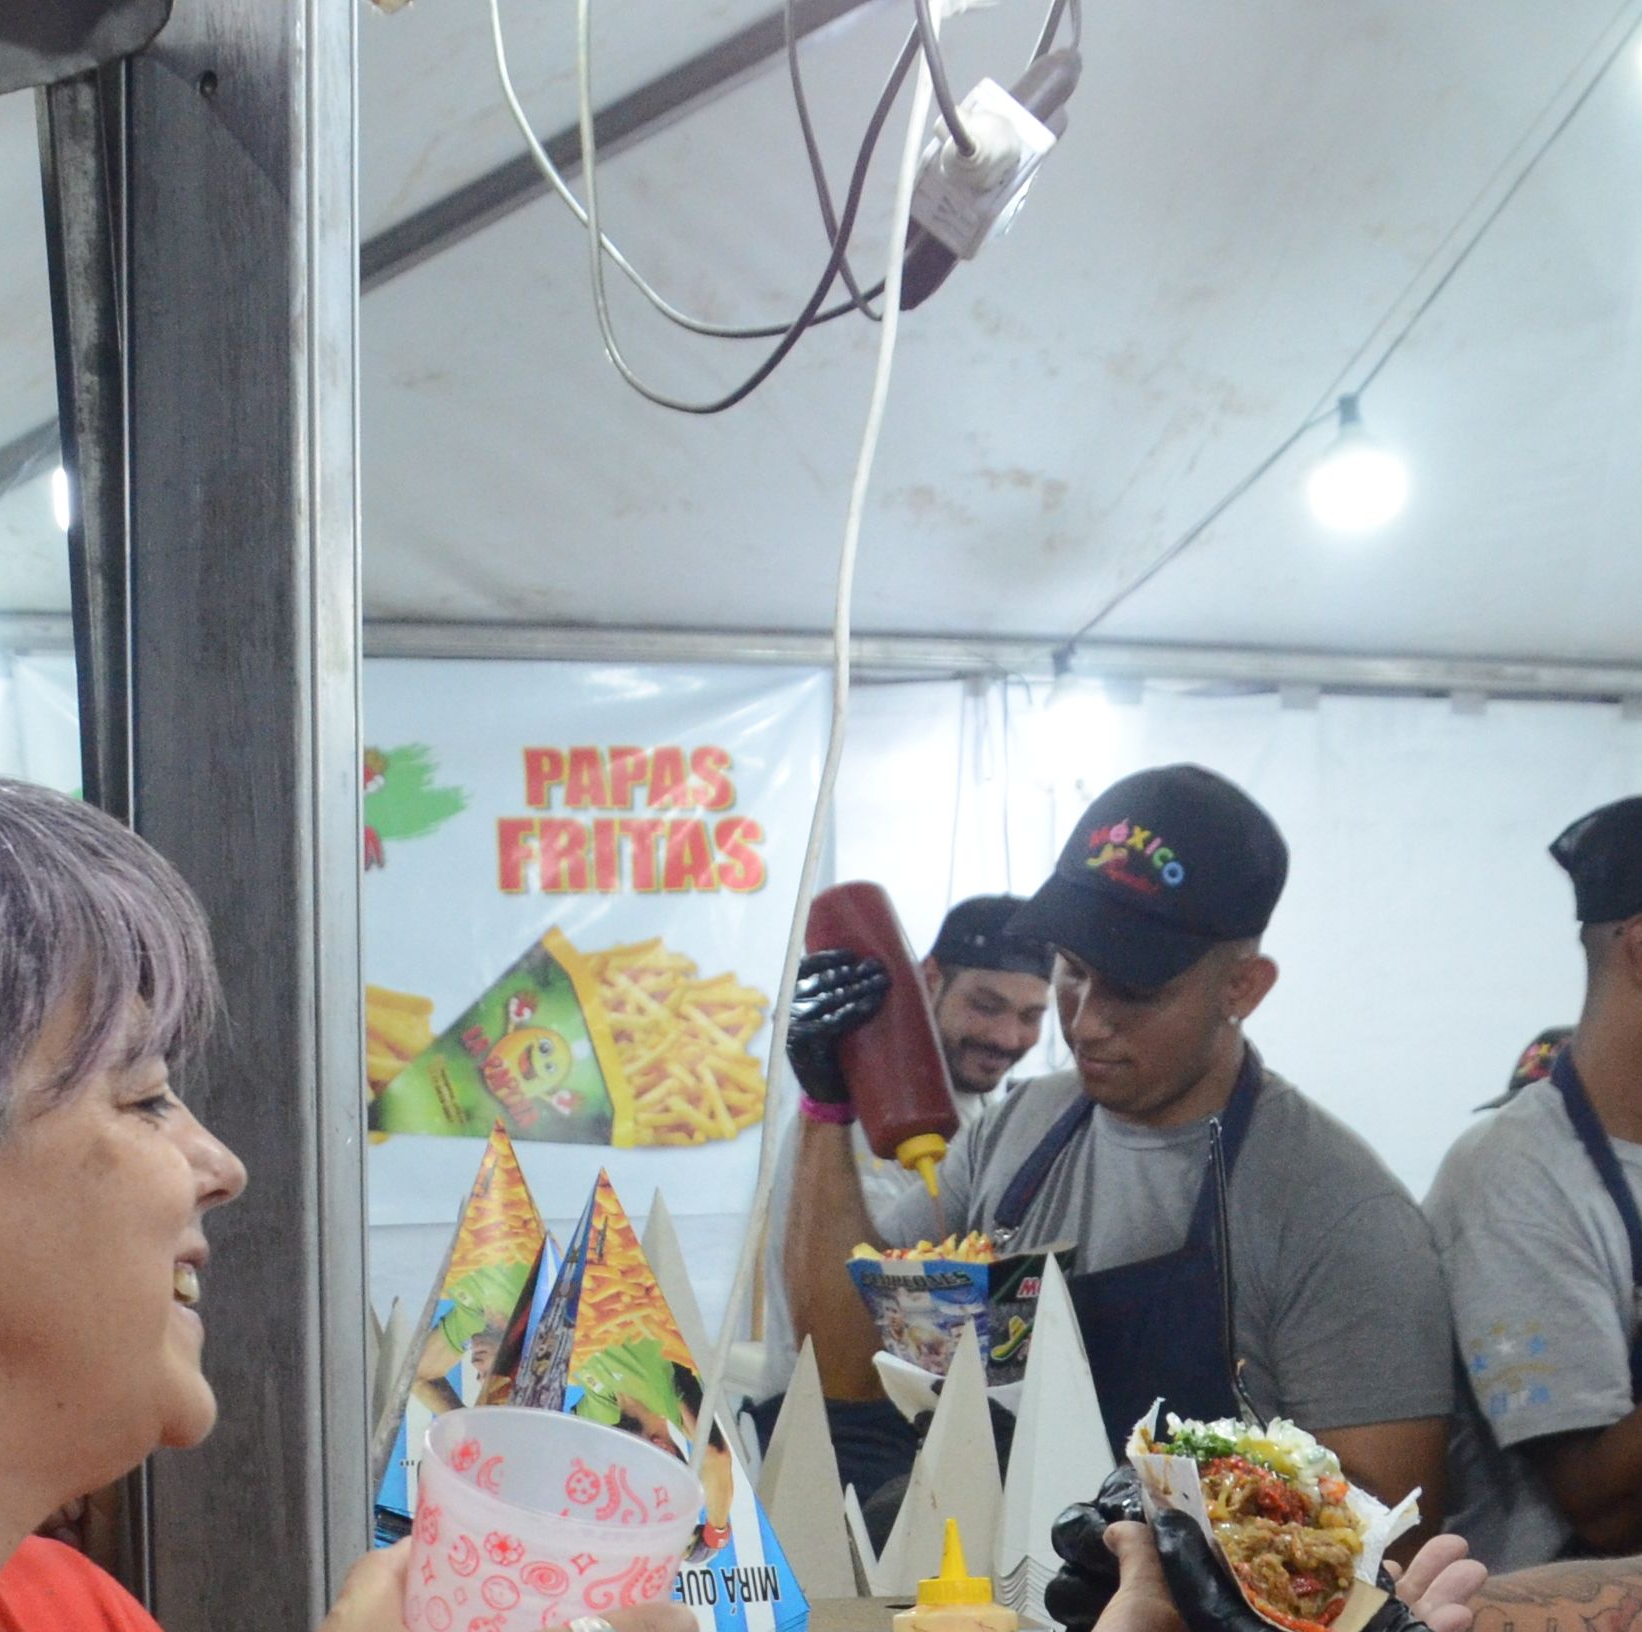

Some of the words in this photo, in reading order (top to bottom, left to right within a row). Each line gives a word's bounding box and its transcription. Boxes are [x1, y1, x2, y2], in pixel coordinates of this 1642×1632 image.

[523, 745, 737, 811] PAPAS
[496, 815, 767, 893] FRITAS
[719, 1566, 781, 1616] MIRÁ
